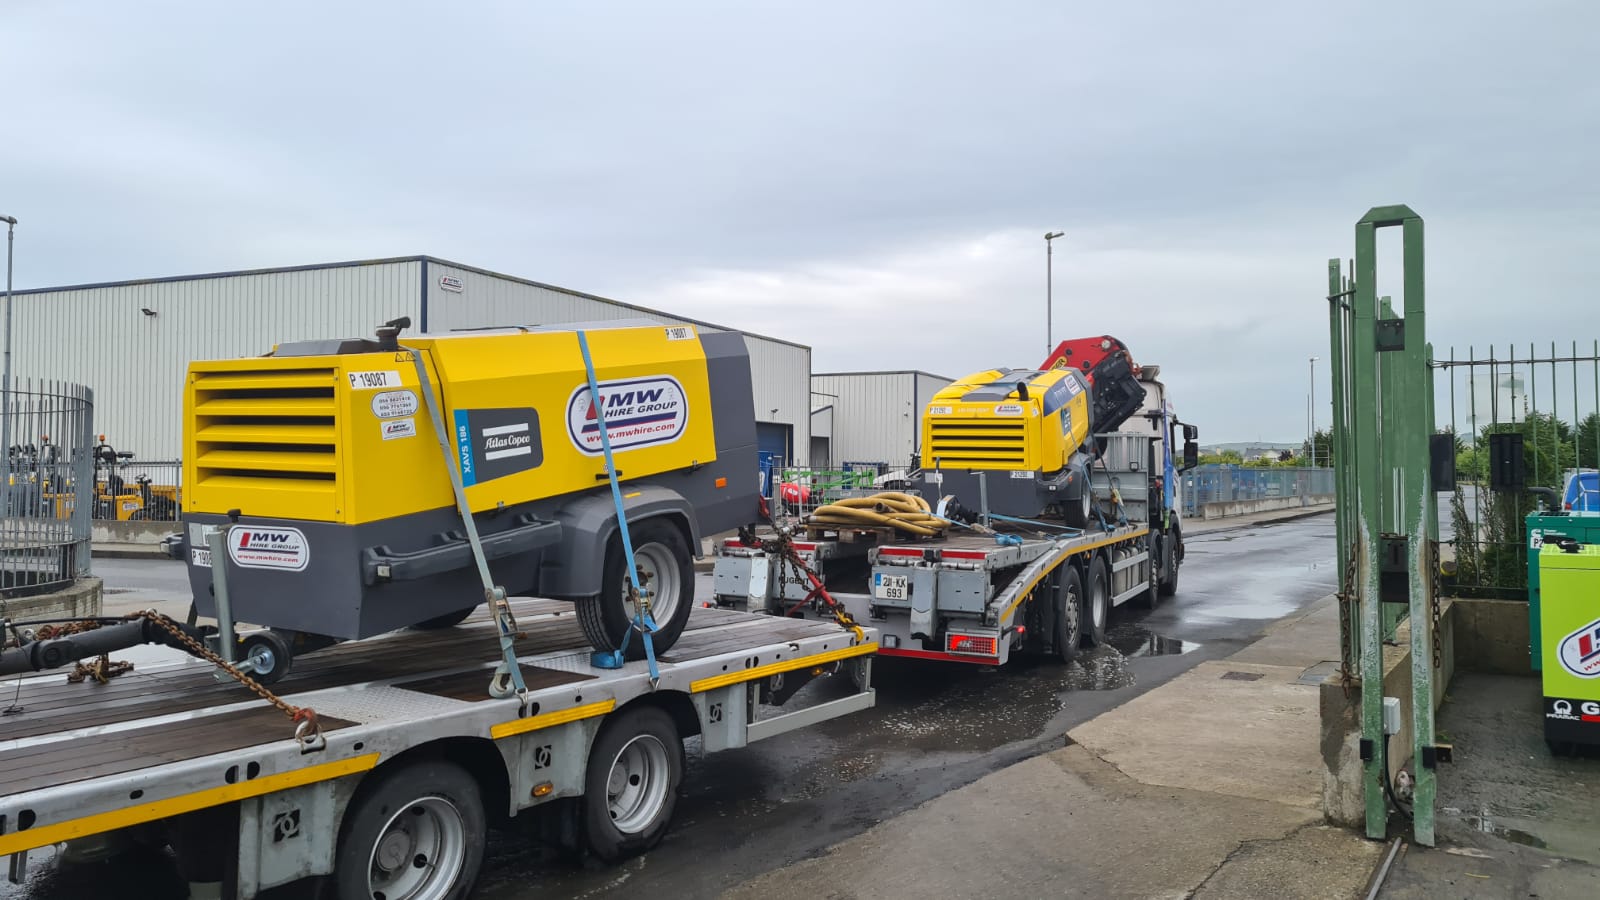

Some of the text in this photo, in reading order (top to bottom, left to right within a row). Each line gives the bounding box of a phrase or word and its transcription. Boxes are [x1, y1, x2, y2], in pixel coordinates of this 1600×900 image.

[349, 372, 387, 387] P 19087
[608, 388, 664, 407] MW
[604, 401, 677, 418] HIRE GROUP
[484, 434, 530, 450] Atlas Copco
[462, 445, 471, 473] XAVS
[252, 533, 290, 542] MW
[193, 550, 197, 559] P
[237, 554, 299, 563] www.mwhire.com
[886, 588, 902, 599] 693
